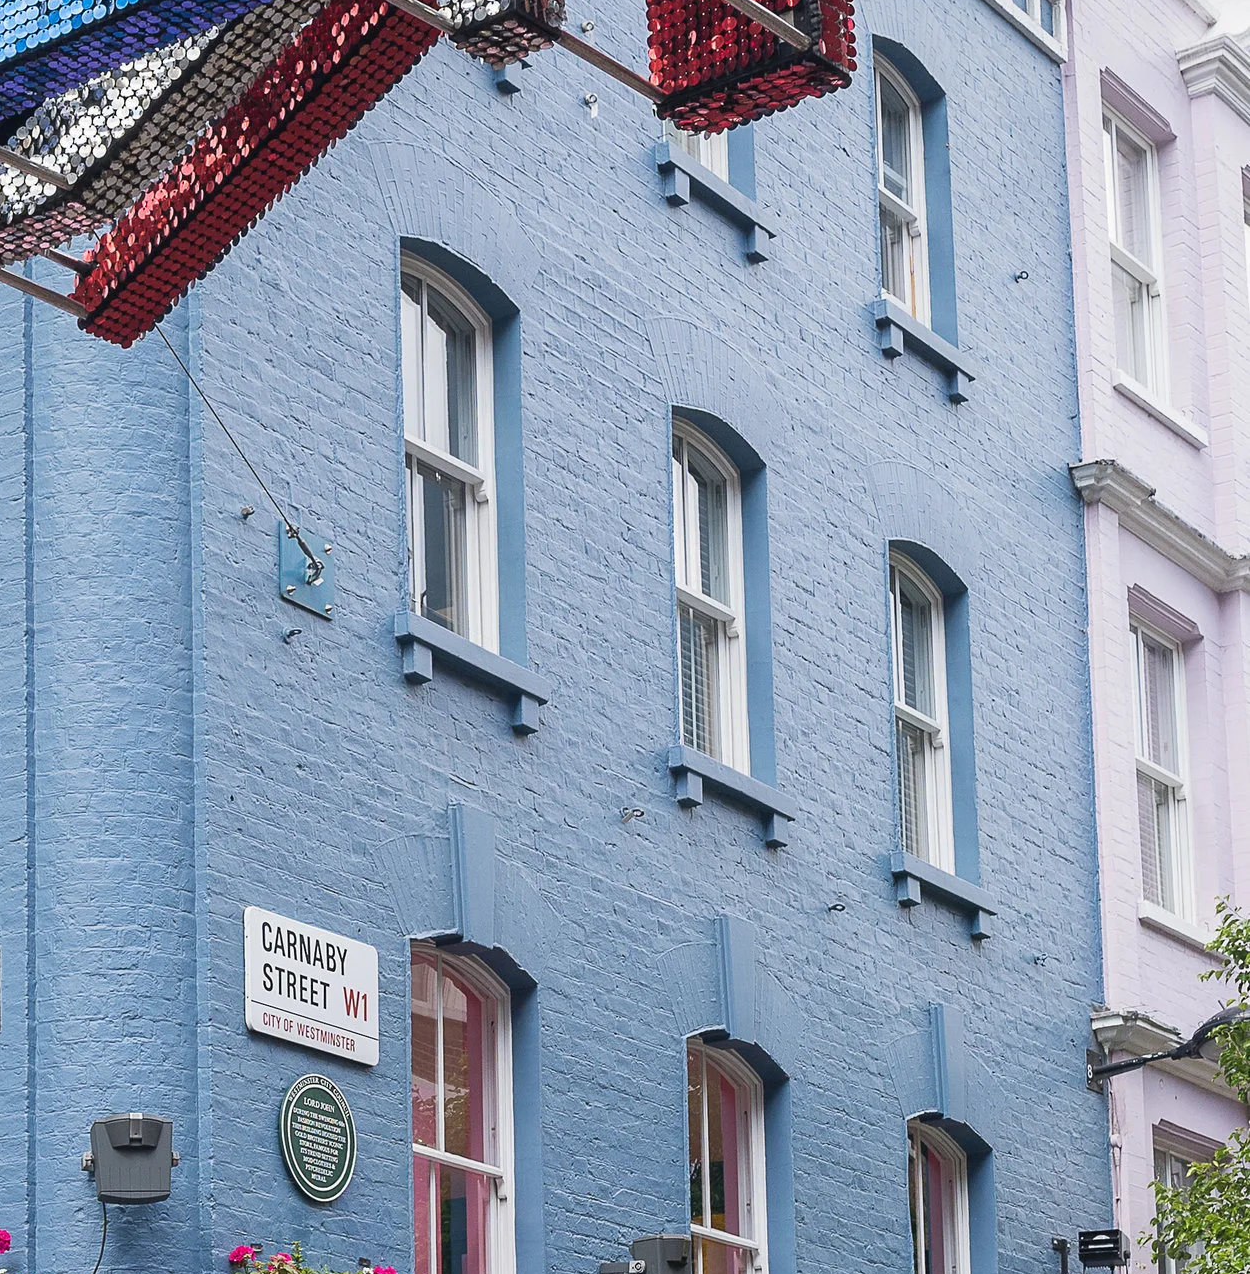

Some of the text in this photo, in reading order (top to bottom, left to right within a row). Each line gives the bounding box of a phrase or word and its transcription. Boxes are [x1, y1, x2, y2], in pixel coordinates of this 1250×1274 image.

[261, 921, 347, 976] CARNABY
[262, 963, 368, 1022] STREET W1
[262, 1012, 356, 1052] CITY OF WESTMINSTER
[303, 1096, 335, 1113] LORD JOHN
